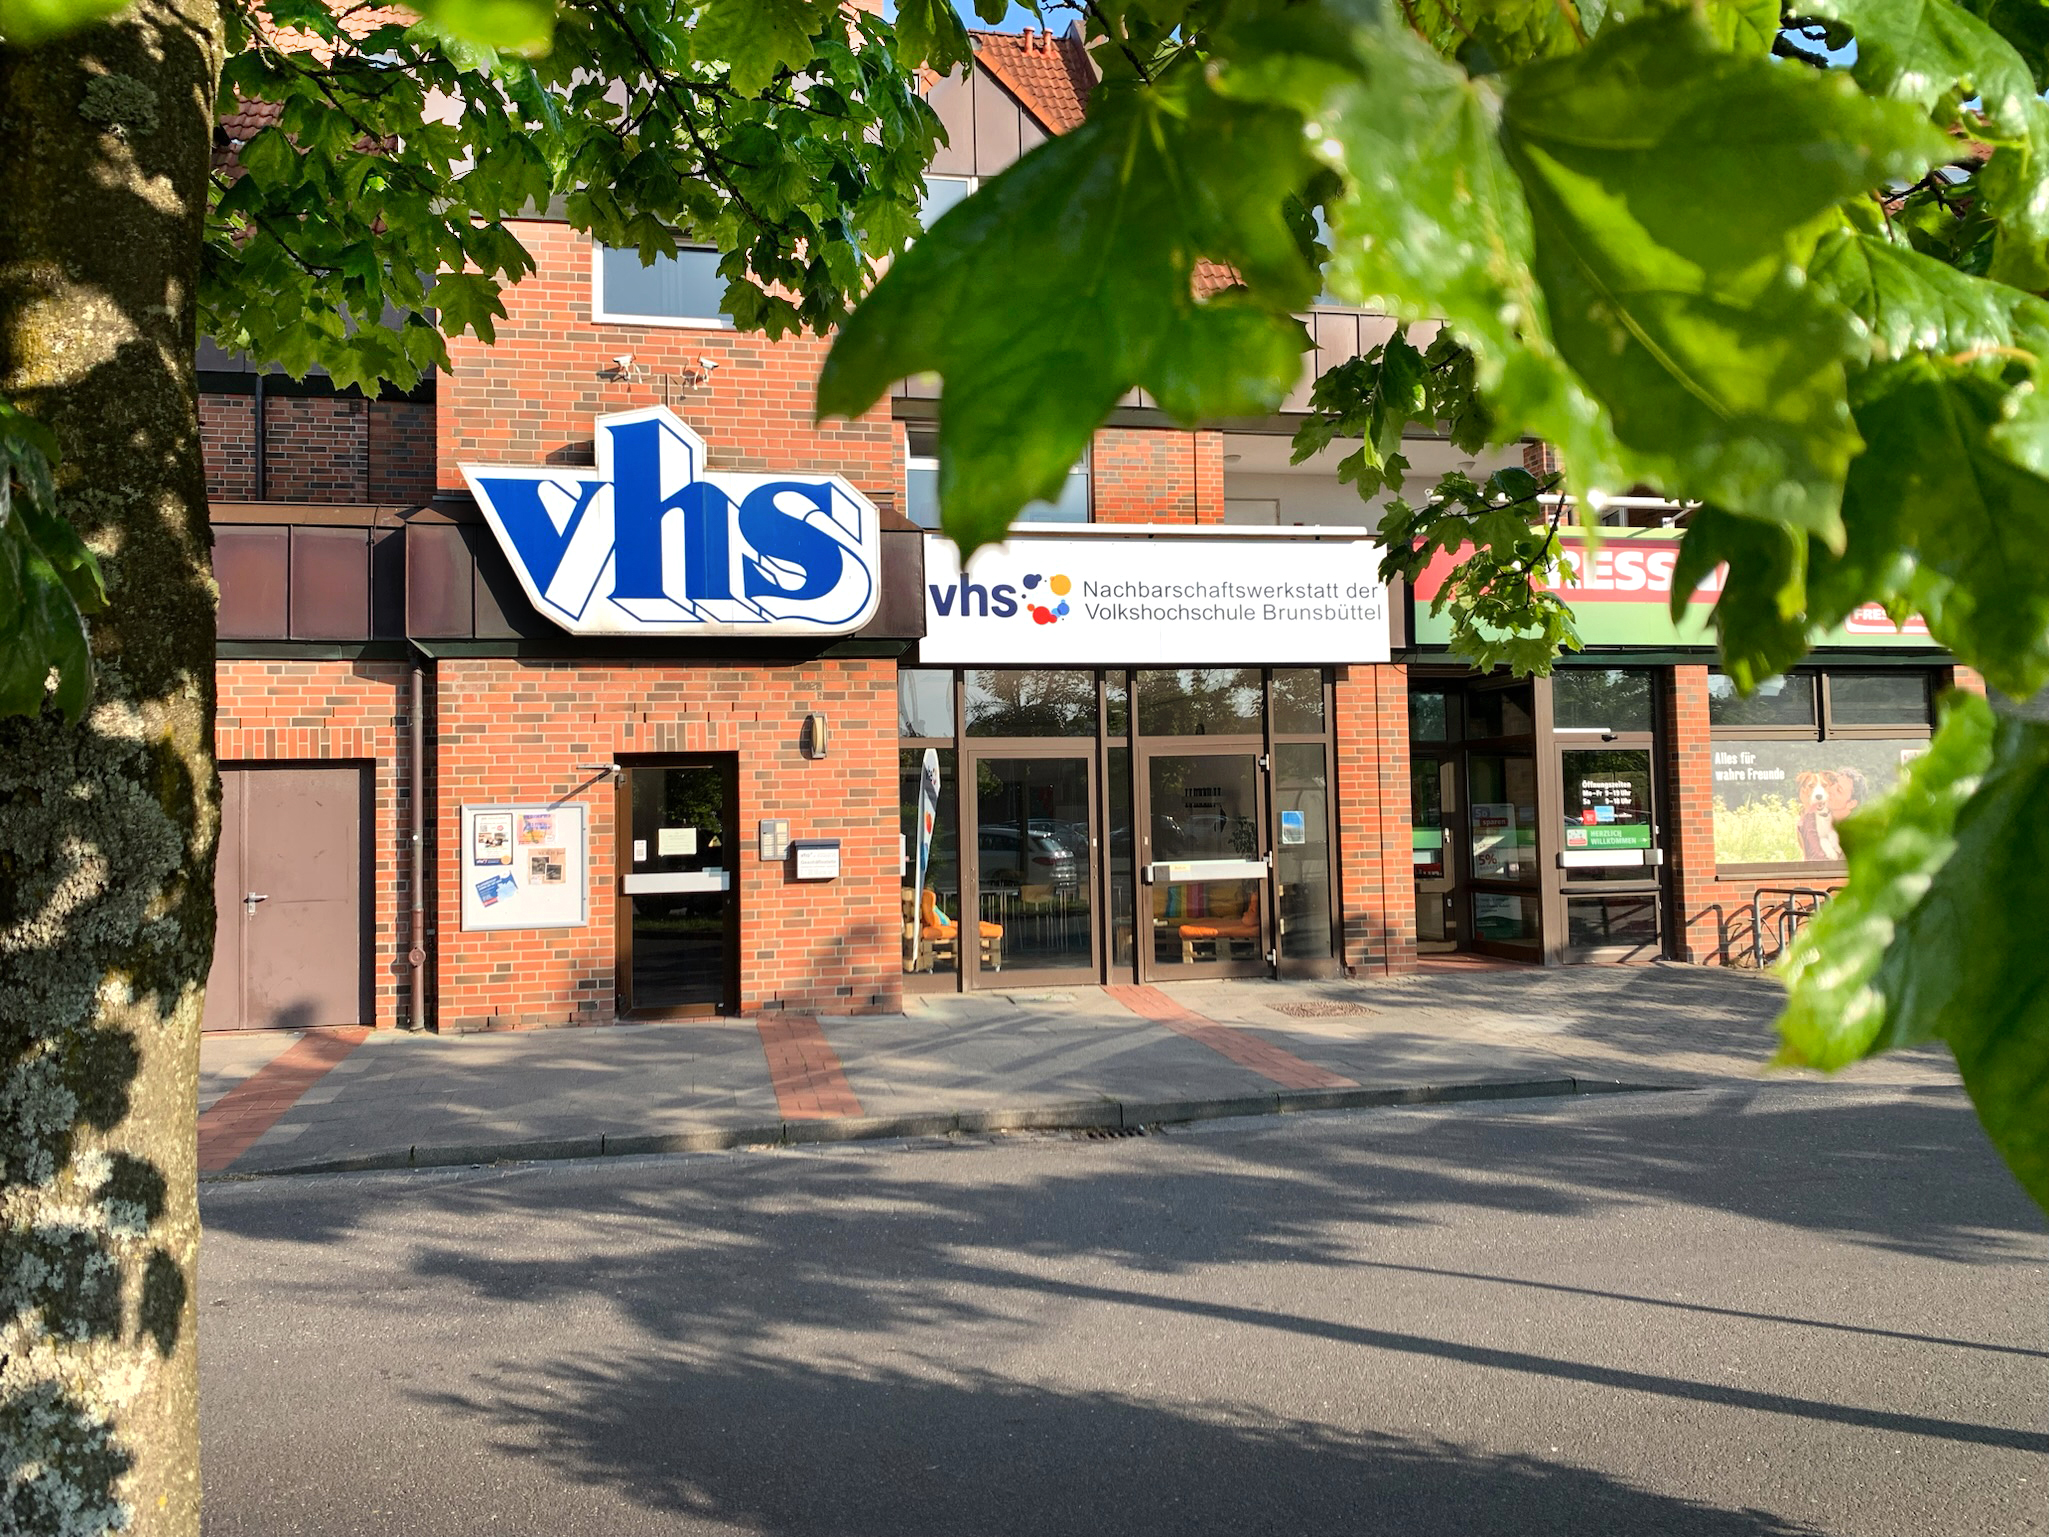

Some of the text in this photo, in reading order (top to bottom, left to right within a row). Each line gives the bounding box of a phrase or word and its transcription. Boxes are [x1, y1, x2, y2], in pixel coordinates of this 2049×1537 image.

[477, 419, 871, 625] vhs
[929, 573, 1018, 618] vhs
[1083, 580, 1378, 599] Nachbarschaftswerkstatt der
[1085, 602, 1382, 621] Volkshochschule Brunsbüttel
[1715, 752, 1756, 765] Alles für
[1715, 768, 1785, 781] wahre Freunde
[1582, 780, 1632, 790] Öffnungszeiten
[1482, 819, 1506, 827] sparen
[1591, 830, 1622, 838] HERZLICH
[1591, 837, 1637, 846] WILLKOMMEN
[1479, 854, 1498, 866] 5%
